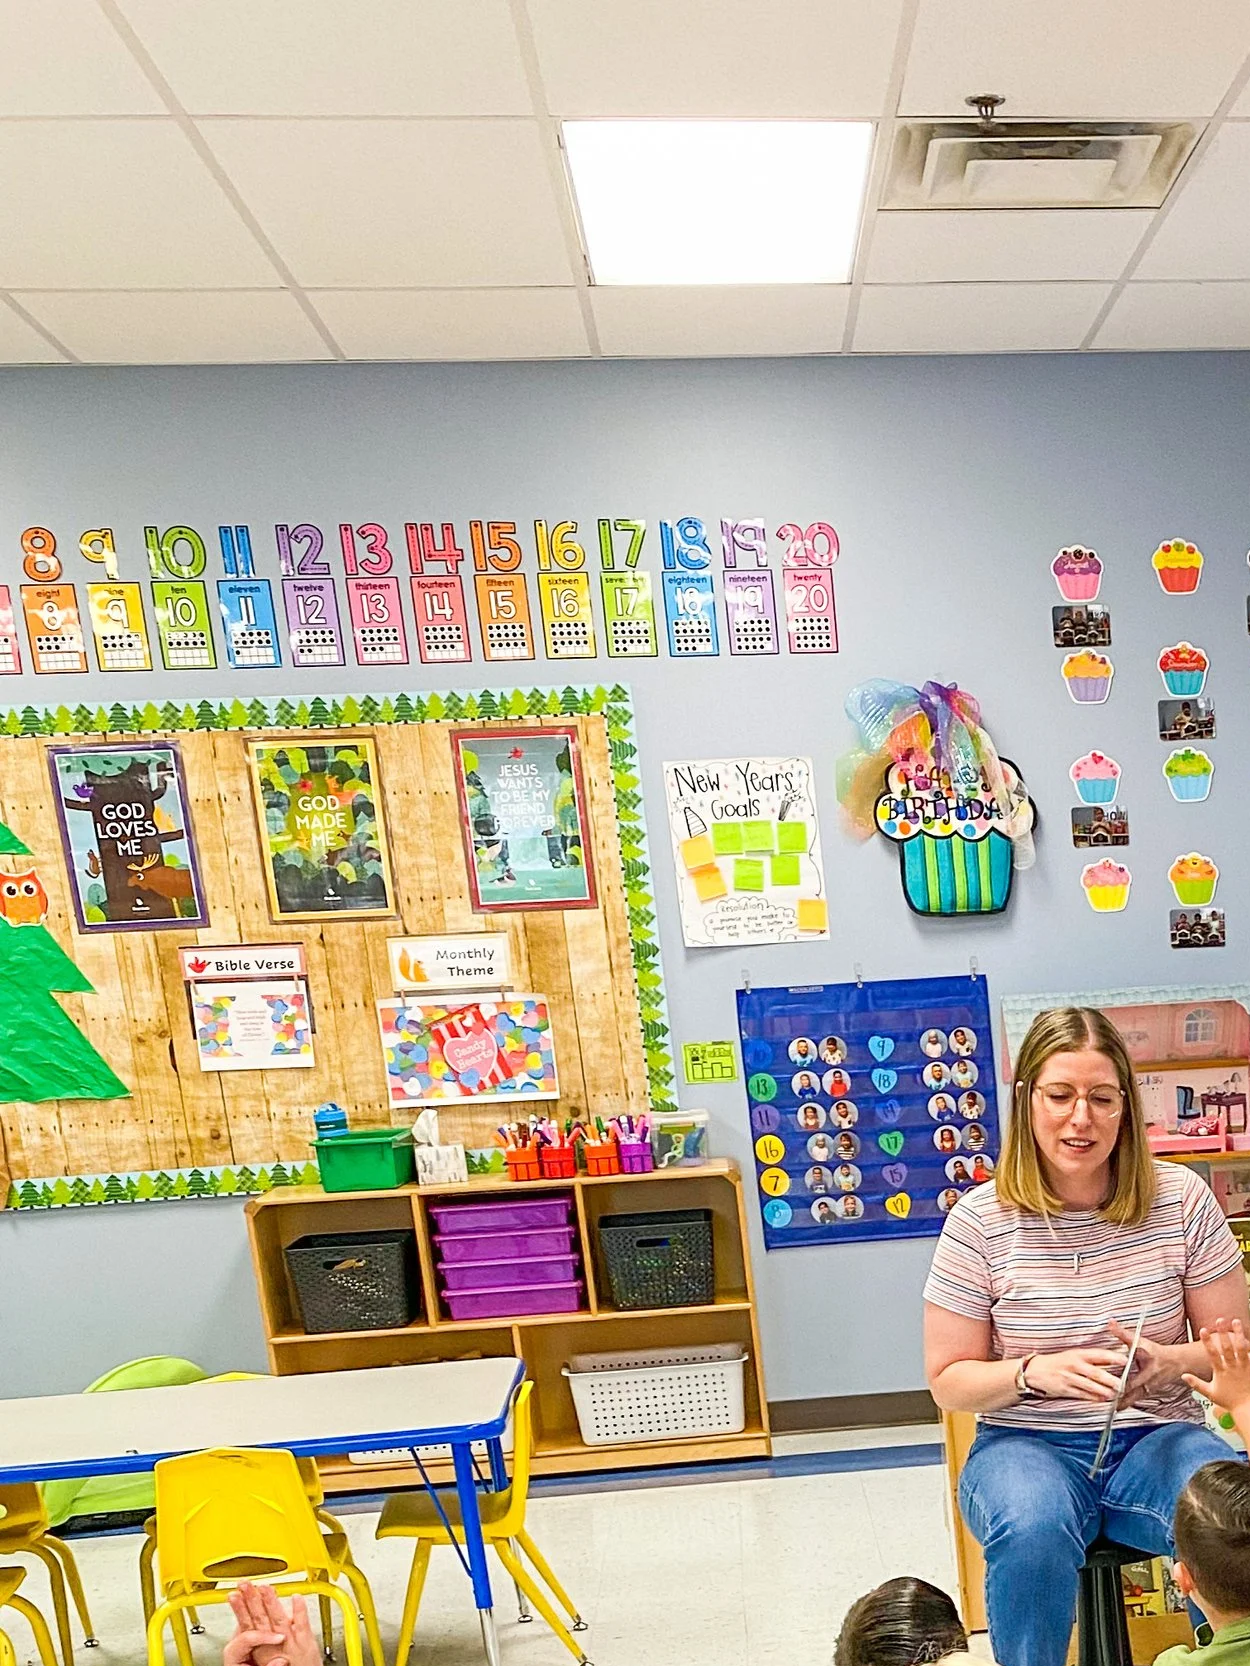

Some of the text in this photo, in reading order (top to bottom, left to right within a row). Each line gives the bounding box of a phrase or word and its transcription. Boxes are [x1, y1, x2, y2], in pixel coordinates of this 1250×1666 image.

[144, 526, 207, 579] 10
[219, 526, 257, 578] 11
[275, 523, 331, 576] 12
[339, 523, 393, 576] 13
[404, 522, 464, 573] 14
[469, 520, 522, 573] 15
[534, 520, 586, 571] 16
[598, 519, 647, 569] 17
[659, 517, 711, 570] 18
[721, 517, 767, 568] 19
[776, 522, 840, 567] 20
[20, 526, 63, 582] 8
[79, 528, 120, 580] 9
[417, 579, 456, 590] fourteen
[668, 576, 707, 585] eighteen
[729, 574, 768, 583] nineteen
[36, 588, 61, 599] eight
[171, 585, 188, 595] ten
[228, 586, 261, 594] eleven
[738, 586, 764, 612] 19
[792, 585, 828, 612] 20
[239, 597, 256, 626] 11
[296, 595, 327, 625] 12
[361, 593, 390, 623] 13
[424, 593, 453, 620] 14
[490, 591, 516, 619] 15
[552, 589, 579, 617] 16
[615, 587, 639, 616] 17
[676, 587, 702, 616] 18
[40, 600, 63, 631] 8
[107, 599, 130, 628] 9
[165, 598, 196, 627] 10
[499, 764, 538, 777] JESUS
[674, 760, 794, 797] New Years
[497, 777, 543, 789] WANTS
[297, 795, 340, 812] GOD
[491, 789, 551, 803] TO BE MY
[101, 803, 145, 821] GOD
[500, 803, 545, 815] FRIEND
[711, 798, 760, 819] Goals
[97, 820, 156, 840] LOVES
[295, 812, 347, 830] MADE
[117, 838, 144, 857] ME
[311, 831, 337, 848] ME
[214, 957, 295, 973] Bible Verse
[435, 947, 495, 965] Monthly
[446, 963, 494, 977] Theme
[877, 1042, 886, 1058] 9
[756, 1078, 768, 1095] 13
[878, 1072, 891, 1087] 18
[758, 1109, 771, 1126] 11
[763, 1140, 779, 1159] 16
[886, 1137, 898, 1150] 17
[768, 1174, 780, 1191] 7
[889, 1169, 903, 1183] 15
[771, 1203, 783, 1219] 8
[892, 1198, 906, 1214] 12
